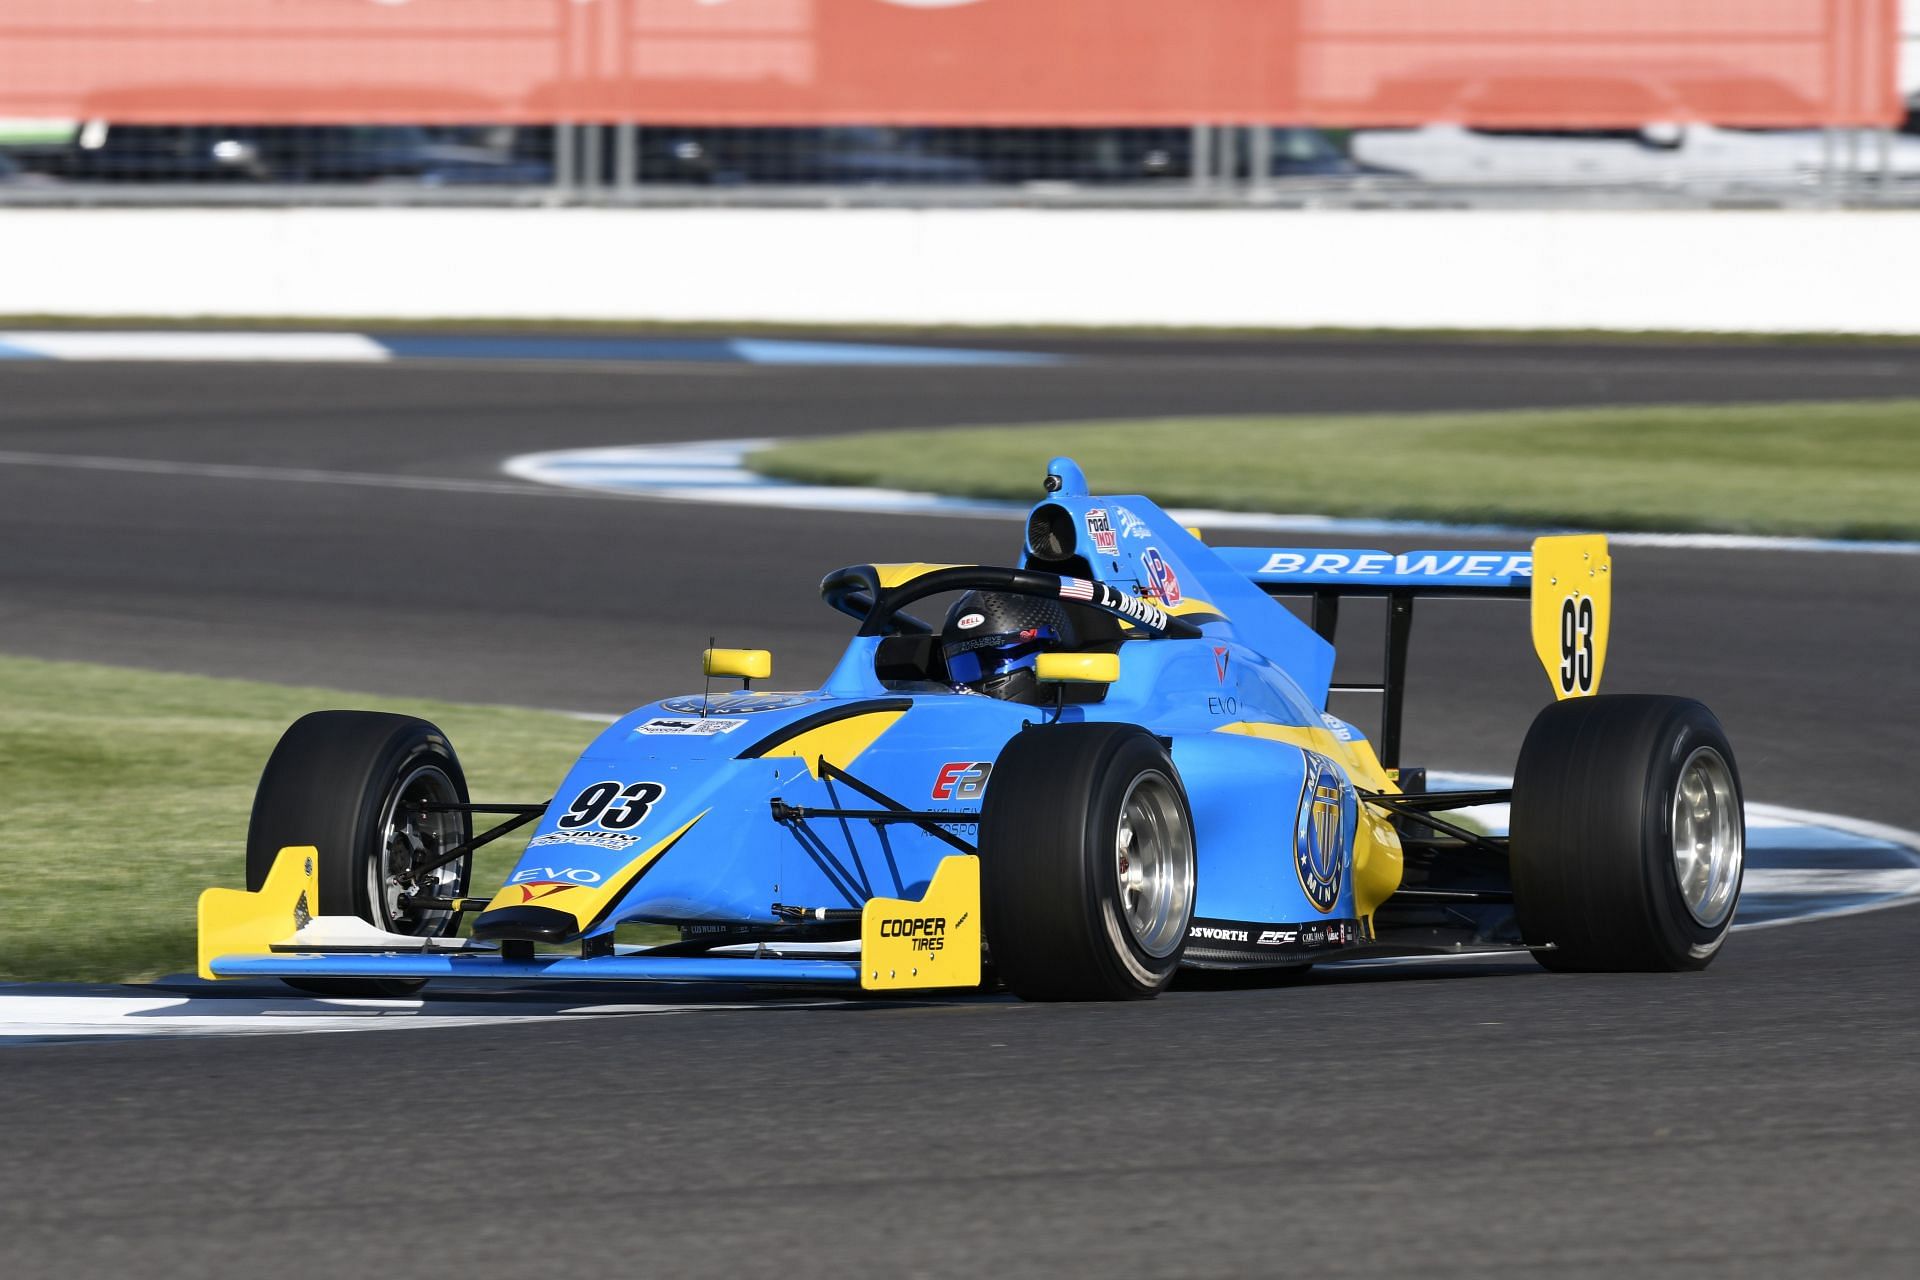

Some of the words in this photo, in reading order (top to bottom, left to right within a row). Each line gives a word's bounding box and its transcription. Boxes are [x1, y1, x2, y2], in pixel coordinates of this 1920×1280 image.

[1087, 512, 1110, 532] road
[1095, 532, 1115, 547] INDY
[1258, 553, 1532, 577] BREWER
[1101, 584, 1117, 608] L.
[1118, 590, 1168, 631] BREWER
[961, 617, 980, 626] BELL
[1561, 597, 1593, 693] 93
[1208, 697, 1237, 715] EVO
[557, 781, 665, 831] 93
[512, 867, 601, 883] EVO
[881, 917, 946, 937] COOPER
[1259, 930, 1298, 941] PFC
[912, 938, 945, 951] TIRES
